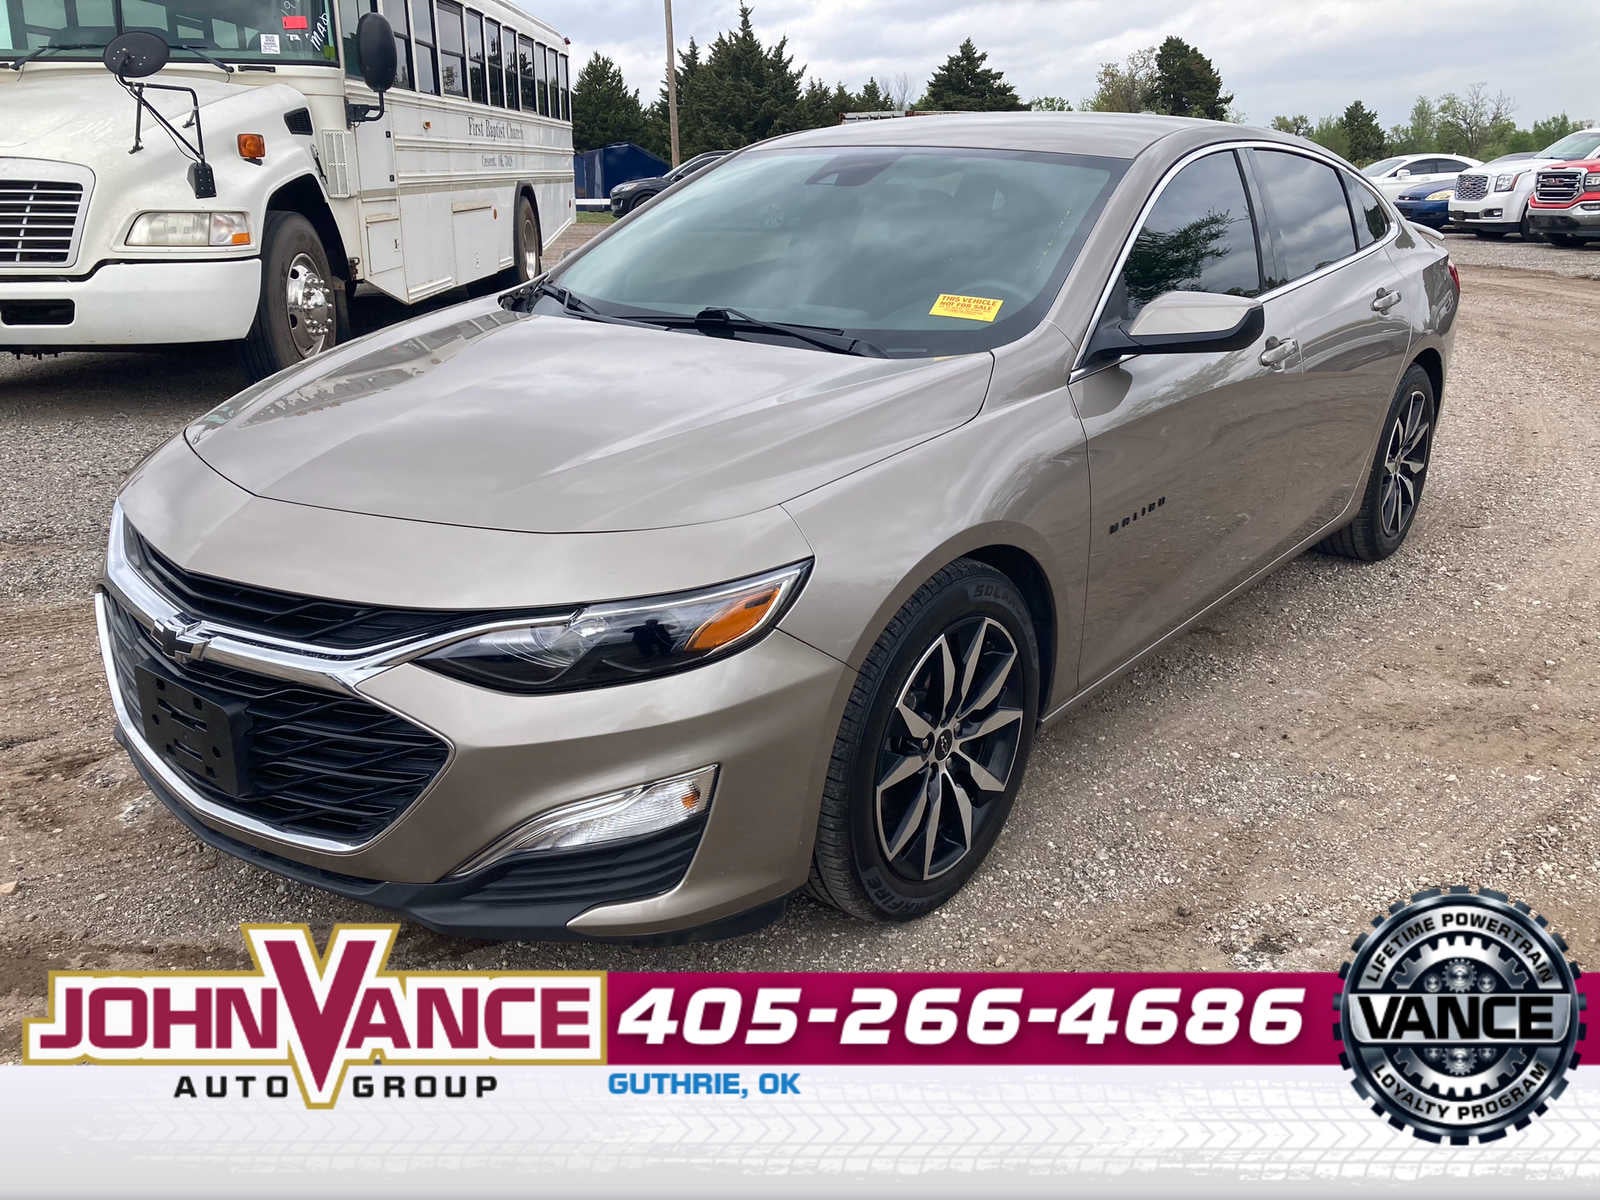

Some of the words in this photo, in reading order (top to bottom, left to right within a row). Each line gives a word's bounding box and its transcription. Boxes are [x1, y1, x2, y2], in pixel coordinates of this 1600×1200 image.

[468, 116, 484, 137] First
[486, 119, 506, 141] Baptist
[507, 121, 524, 140] Church
[962, 297, 998, 307] VEHICLE
[1109, 496, 1166, 535] MALIBU
